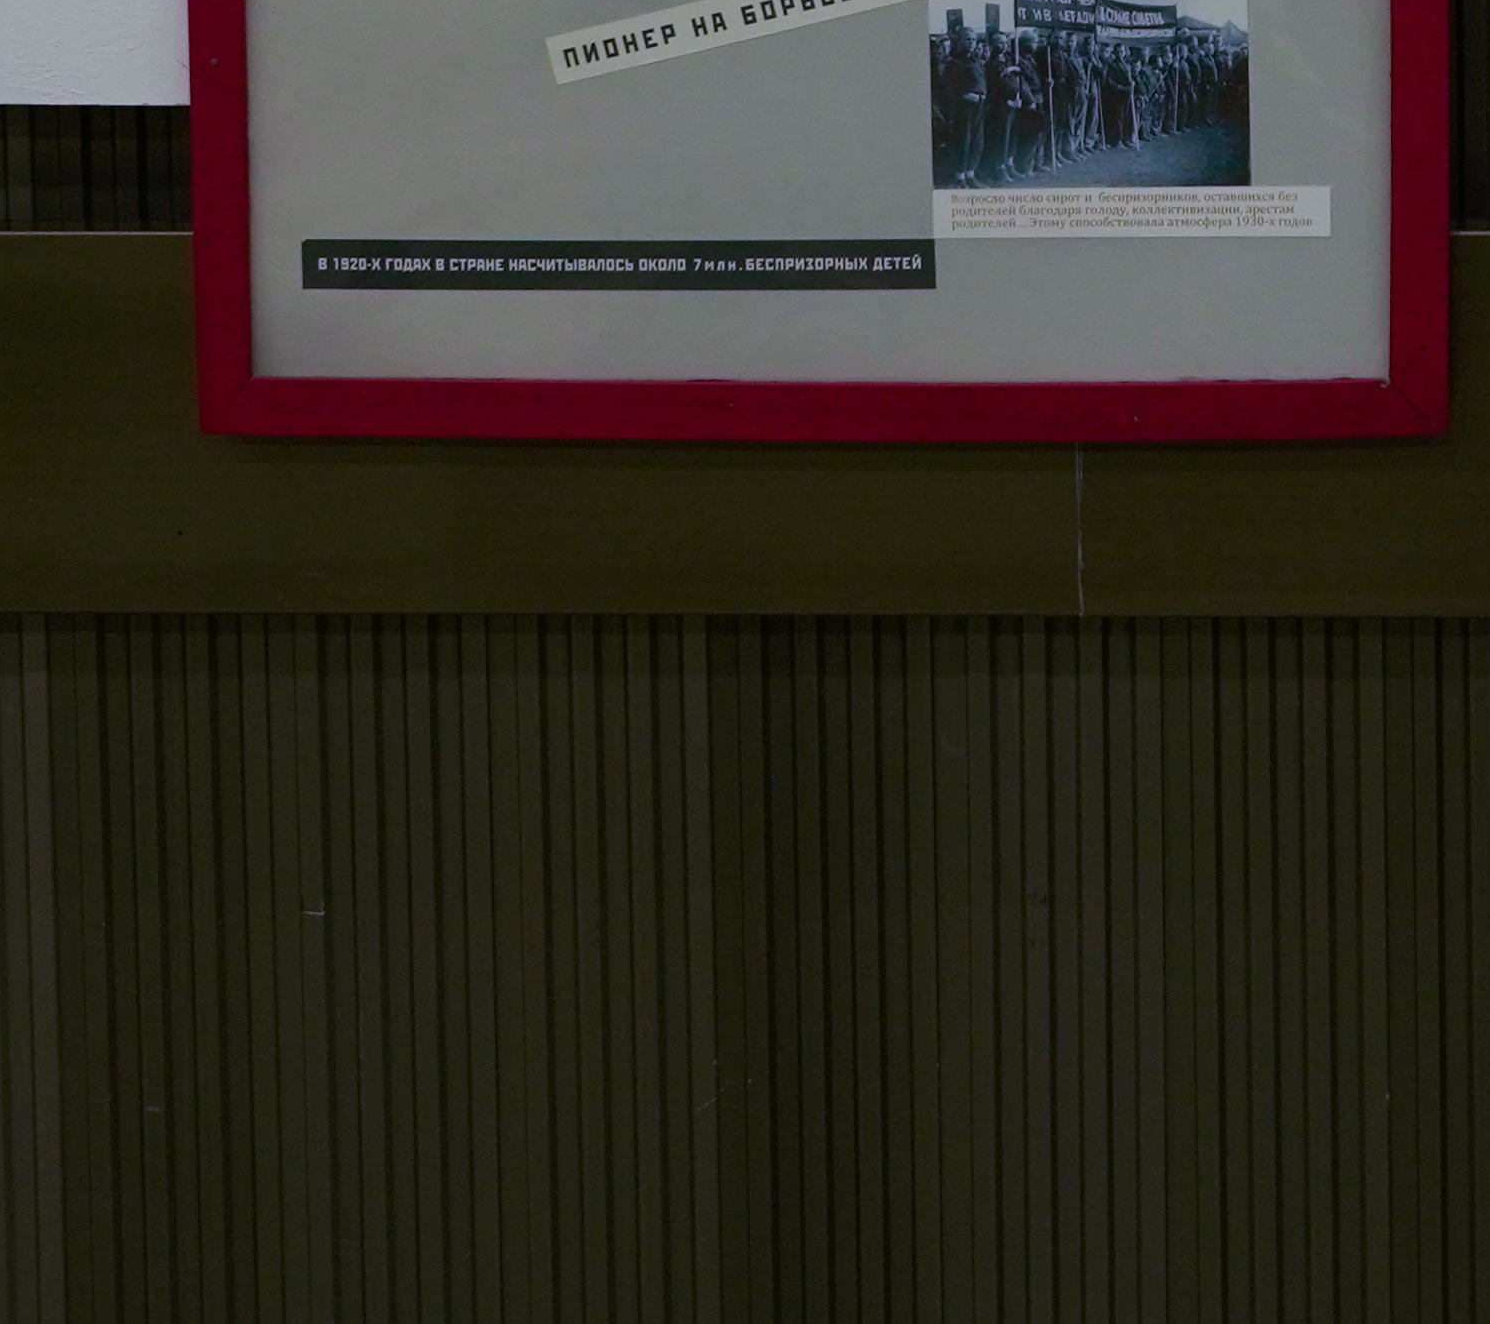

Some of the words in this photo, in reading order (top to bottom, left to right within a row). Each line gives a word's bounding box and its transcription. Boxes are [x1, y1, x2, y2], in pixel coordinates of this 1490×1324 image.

[563, 23, 677, 69] ПИОНЕР
[691, 11, 727, 37] НА
[317, 256, 327, 270] В
[332, 256, 381, 270] 1920-Х
[385, 257, 431, 272] ГОДАХ
[435, 257, 445, 271] В
[449, 257, 504, 271] СТРАНЕ
[508, 257, 634, 271] НАСЧИТЫВАЛОСЬ
[638, 257, 686, 271] ОКОЛО
[745, 257, 868, 271] БЕСПРИЗОРНЫХ
[872, 253, 921, 271] ДЕТЕЙ
